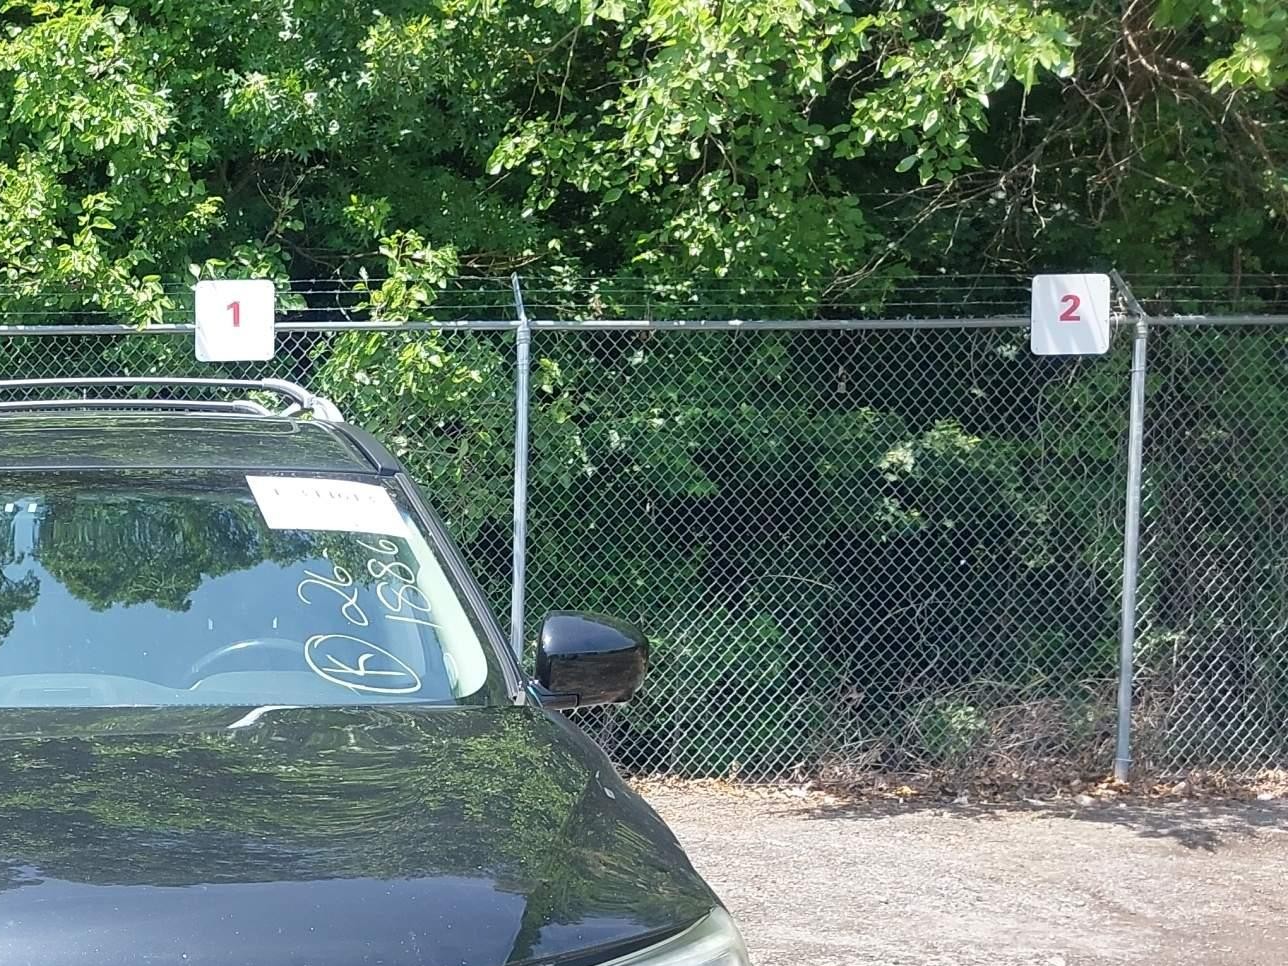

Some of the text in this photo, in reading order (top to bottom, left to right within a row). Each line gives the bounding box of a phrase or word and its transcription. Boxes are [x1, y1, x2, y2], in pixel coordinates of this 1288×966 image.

[226, 300, 241, 328] 1
[1059, 294, 1081, 321] 2
[356, 538, 442, 629] 1886
